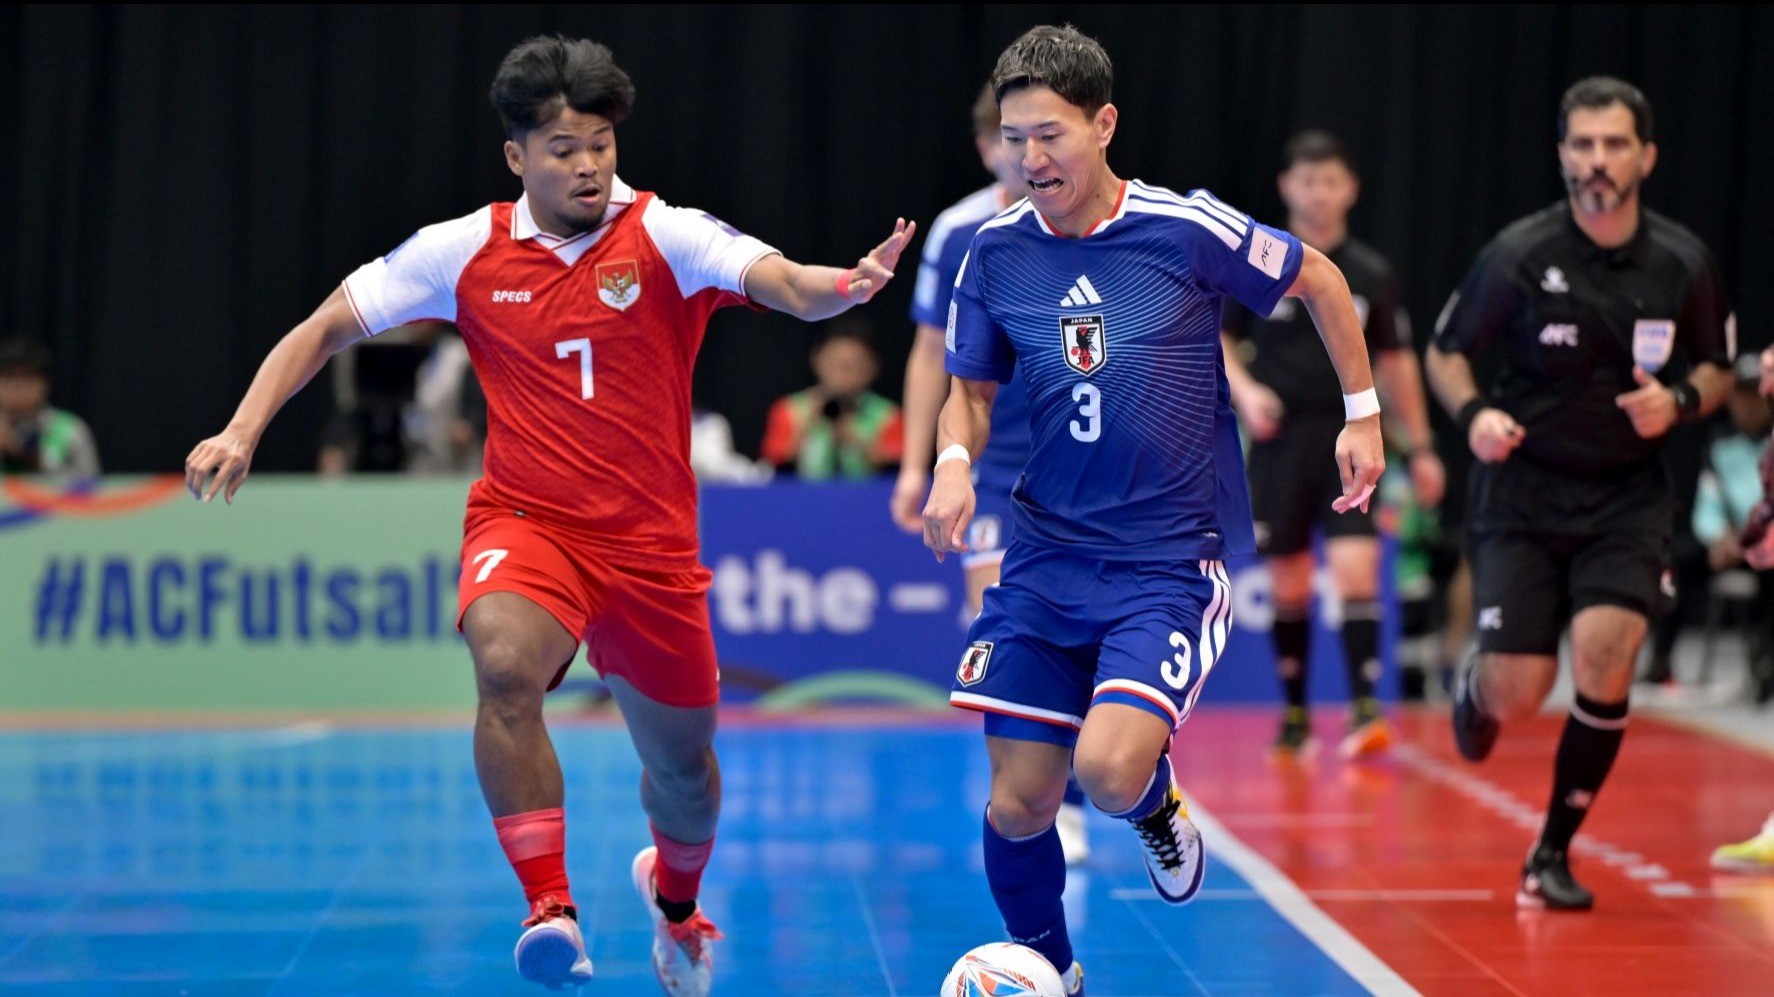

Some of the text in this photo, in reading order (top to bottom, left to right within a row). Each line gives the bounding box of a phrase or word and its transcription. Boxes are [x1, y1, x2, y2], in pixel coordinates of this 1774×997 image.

[1261, 238, 1272, 268] AFC
[492, 289, 532, 303] SPECS
[555, 337, 595, 400] 7
[1068, 381, 1102, 443] 3
[471, 549, 509, 584] 7
[713, 550, 875, 634] the
[34, 552, 461, 645] #ACFutsal
[1160, 630, 1192, 690] 3
